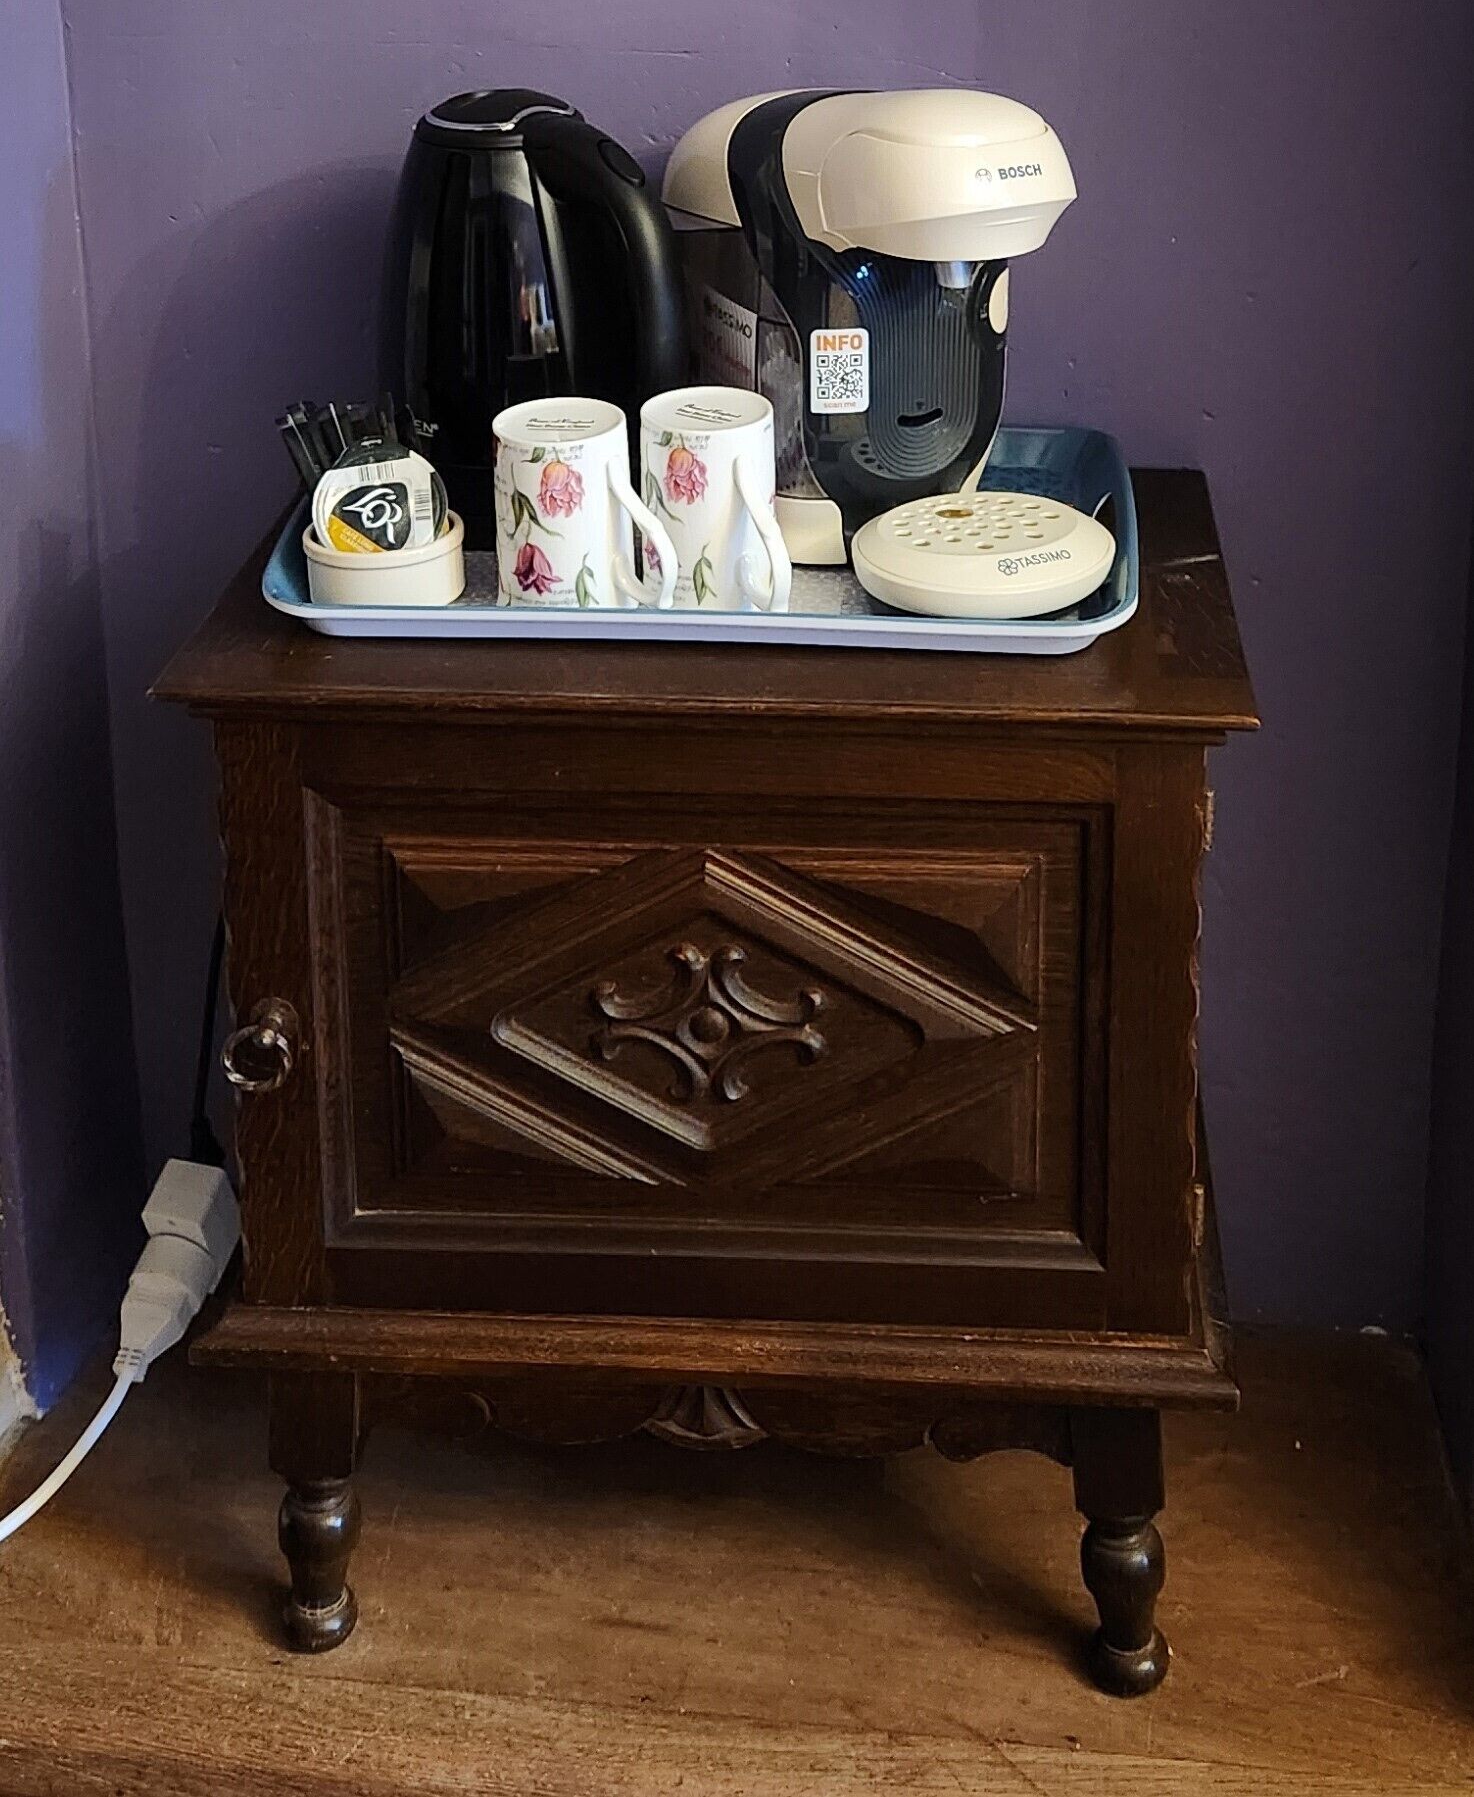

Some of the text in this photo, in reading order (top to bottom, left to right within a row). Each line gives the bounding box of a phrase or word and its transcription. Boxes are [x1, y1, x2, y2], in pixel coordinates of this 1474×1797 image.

[998, 163, 1042, 180] BOSCH
[816, 334, 863, 351] INFO
[1014, 549, 1071, 568] TASSIMO
